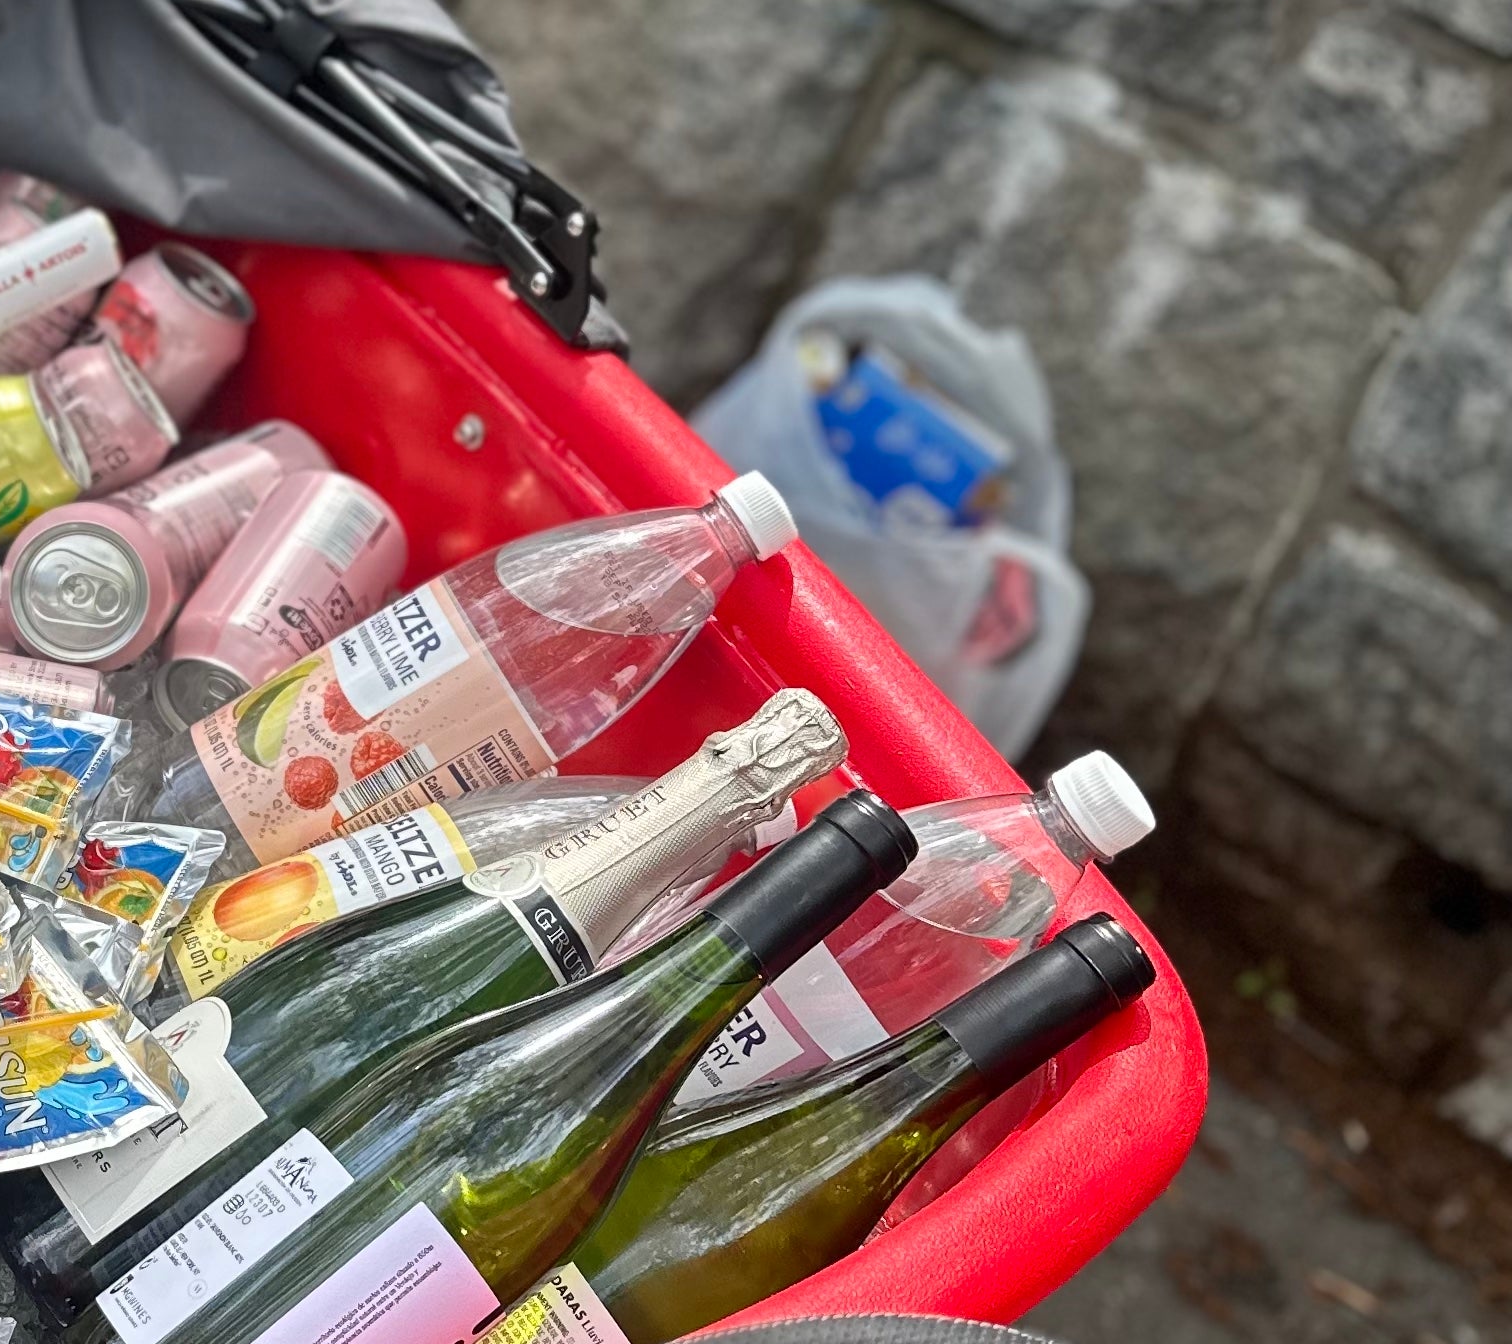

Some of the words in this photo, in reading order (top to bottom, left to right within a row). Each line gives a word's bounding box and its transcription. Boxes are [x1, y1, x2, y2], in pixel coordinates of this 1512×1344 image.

[39, 241, 87, 272] ARTOIS
[384, 642, 419, 686] LIME
[295, 699, 318, 722] zero
[304, 716, 339, 757] calories
[496, 727, 524, 764] CONTAINS
[219, 757, 236, 772] 1L
[541, 783, 671, 865] GRUET
[364, 831, 405, 888] MANGO
[383, 809, 447, 894] ELTZE
[197, 969, 216, 985] 1L
[707, 1032, 740, 1070] RY
